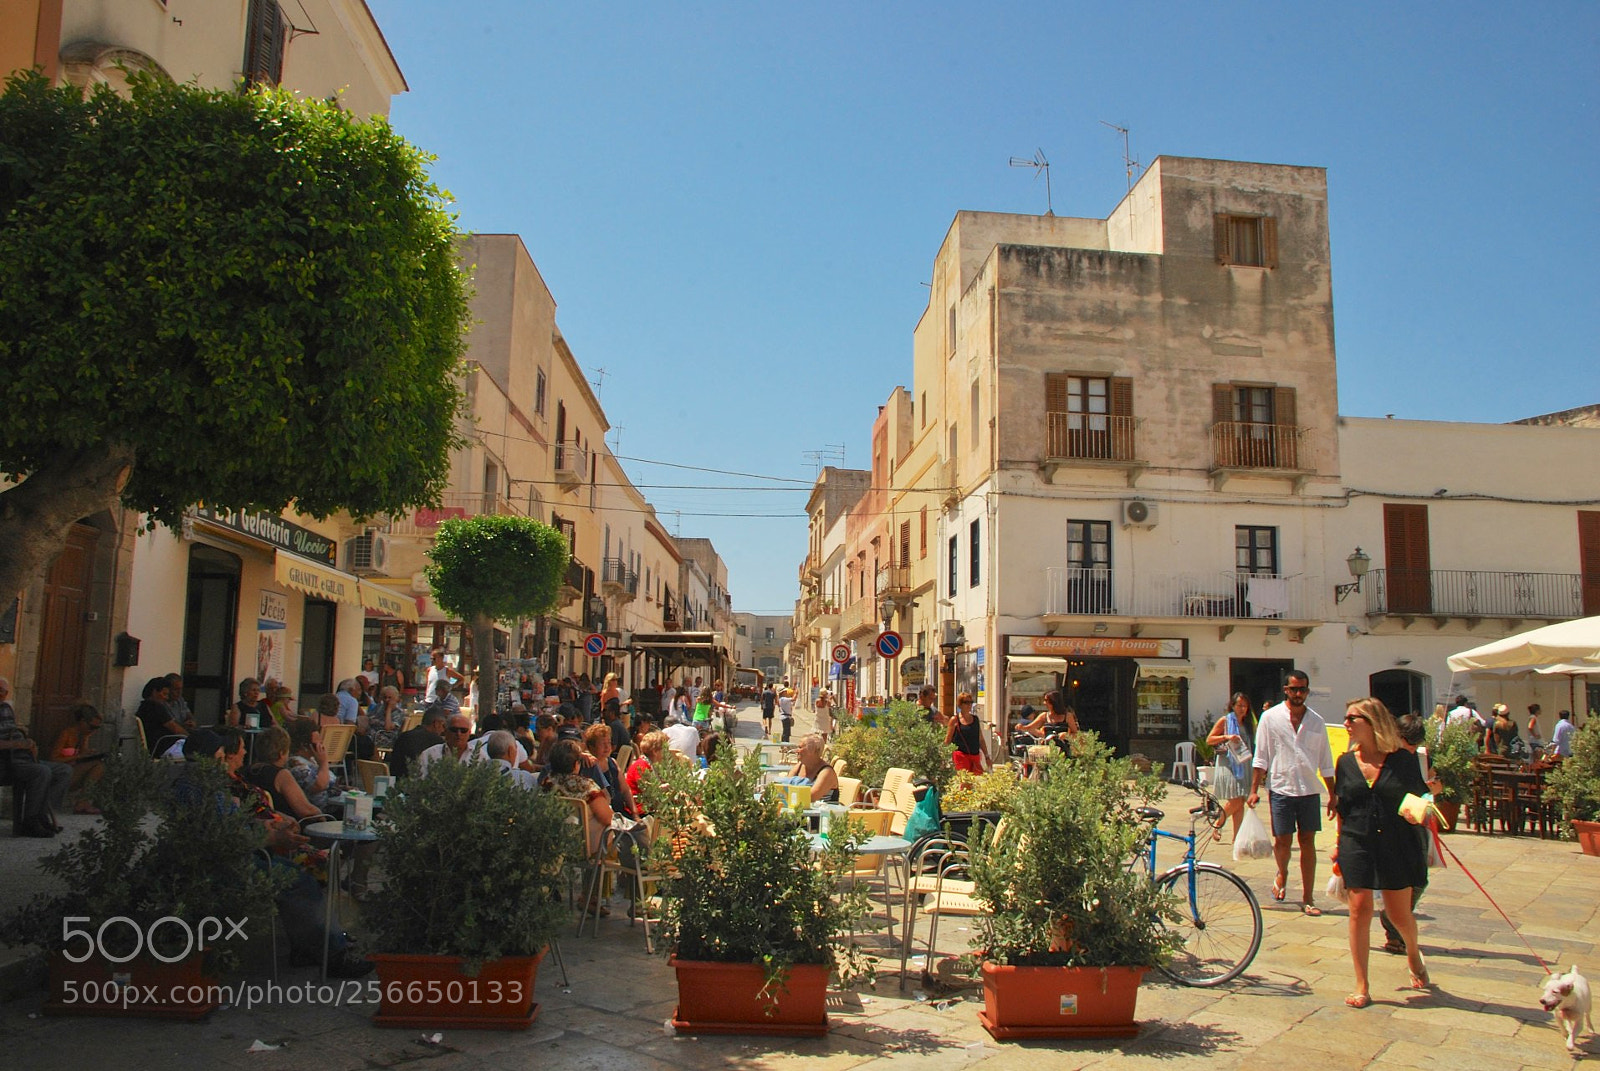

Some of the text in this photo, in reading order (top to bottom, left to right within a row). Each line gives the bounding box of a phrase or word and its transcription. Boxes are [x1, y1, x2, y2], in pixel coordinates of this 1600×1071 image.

[241, 507, 290, 546] Gelateria
[289, 567, 319, 589] GRANITE
[326, 579, 345, 597] GELATI
[260, 595, 286, 621] Uccio
[836, 649, 847, 659] 30
[1095, 638, 1115, 649] del
[1120, 639, 1158, 649] Tonno
